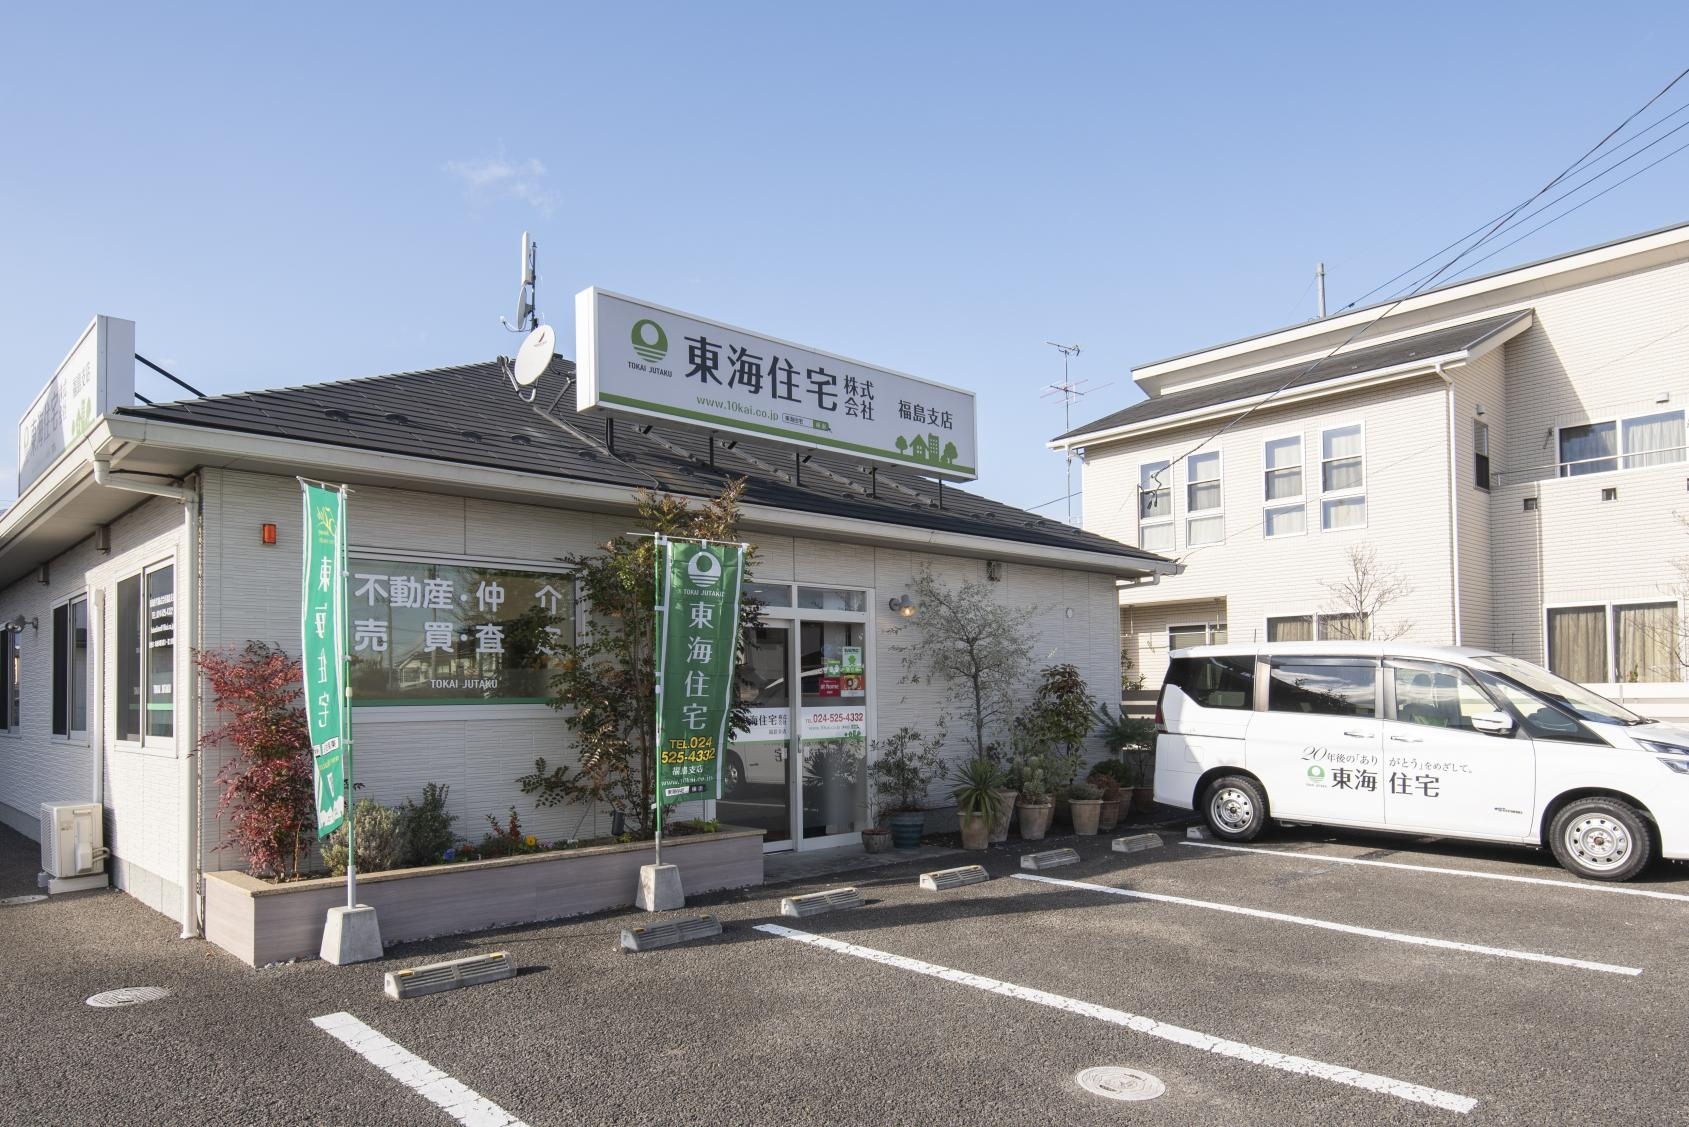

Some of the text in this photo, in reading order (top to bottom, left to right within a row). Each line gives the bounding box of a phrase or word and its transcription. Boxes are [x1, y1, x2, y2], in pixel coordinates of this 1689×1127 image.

[628, 361, 673, 378] TOKAI JUTAKU
[684, 336, 839, 411] 東海住宅
[697, 396, 779, 421] www.10kai.co.jp
[898, 400, 953, 430] 福島支店
[682, 601, 716, 731] 東海住宅
[430, 679, 498, 689] TOKAI JUTAKU
[813, 712, 864, 723] 024-525-4332
[1331, 767, 1440, 797] 東海住宅
